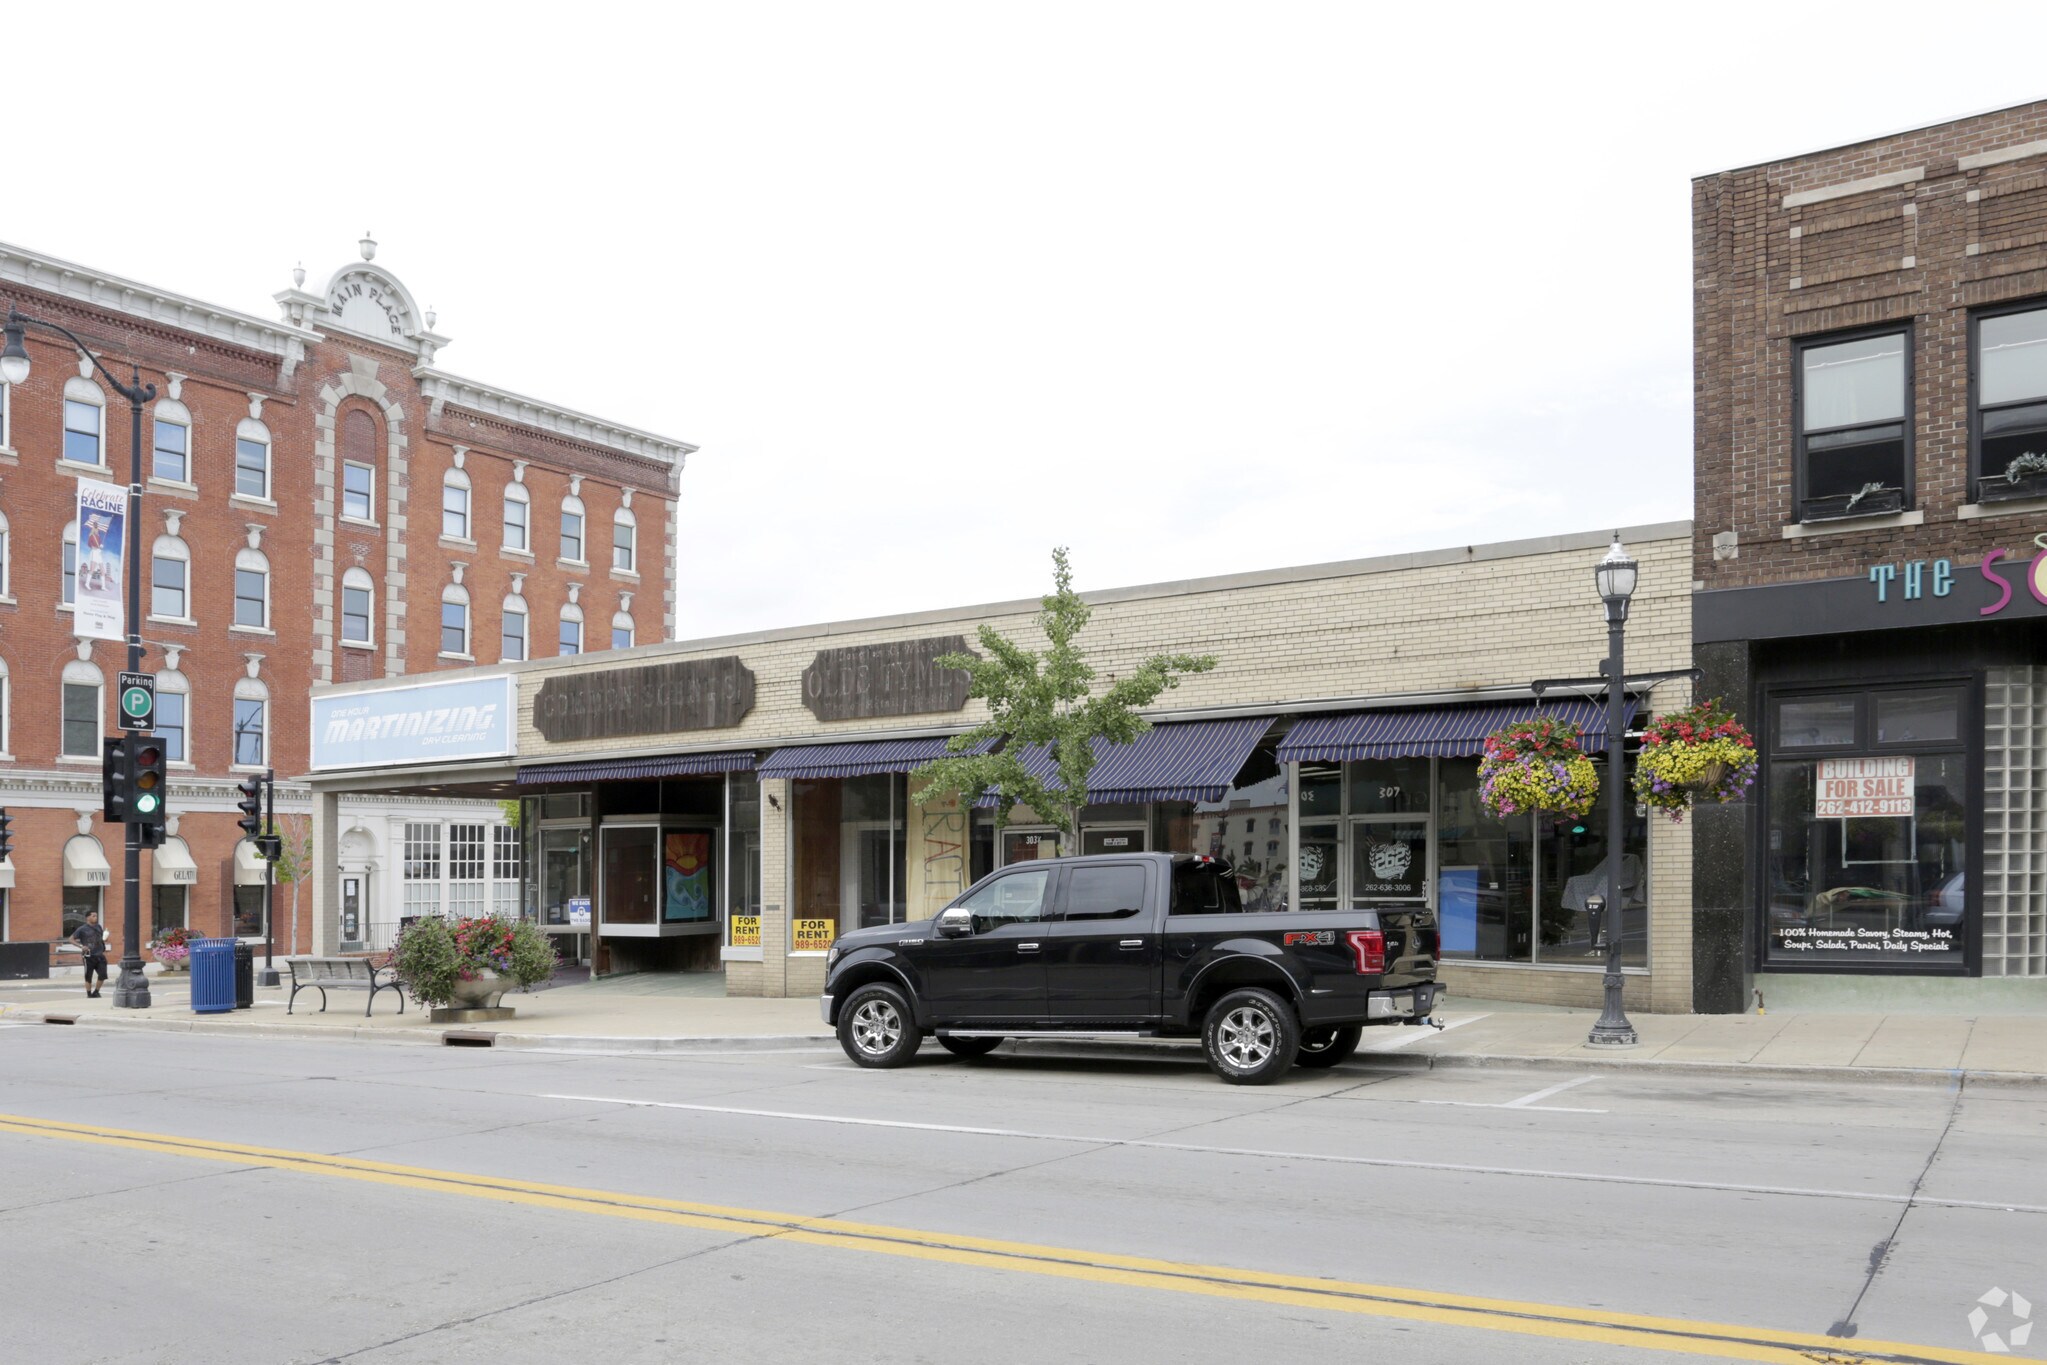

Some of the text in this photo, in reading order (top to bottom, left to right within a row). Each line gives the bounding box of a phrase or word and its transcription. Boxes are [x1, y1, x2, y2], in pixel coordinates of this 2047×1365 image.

[332, 283, 401, 335] MAIN PLACE
[81, 496, 124, 514] RACINE
[121, 675, 153, 688] Parking
[808, 665, 871, 699] OLDE
[131, 693, 144, 711] P
[543, 685, 635, 717] COMMON
[331, 706, 370, 718] ONE HOUR
[422, 732, 487, 745] DRY CLEANING
[1822, 758, 1909, 779] BUILDING
[1379, 786, 1400, 799] 307
[1825, 778, 1905, 798] FOR SALE
[1818, 798, 1911, 814] 262-412-9113
[1375, 847, 1406, 870] 262
[1365, 884, 1411, 892] 262-636-3006
[738, 916, 757, 925] FOR
[801, 920, 825, 929] FOR
[735, 926, 760, 935] RENT
[797, 930, 829, 939] RENT
[1779, 928, 1953, 940] 100% Homemade Savory, Steamy, Hot,
[1284, 931, 1336, 946] FX4
[1784, 939, 1949, 952] Soups, Salads, Panini, Daily Specials
